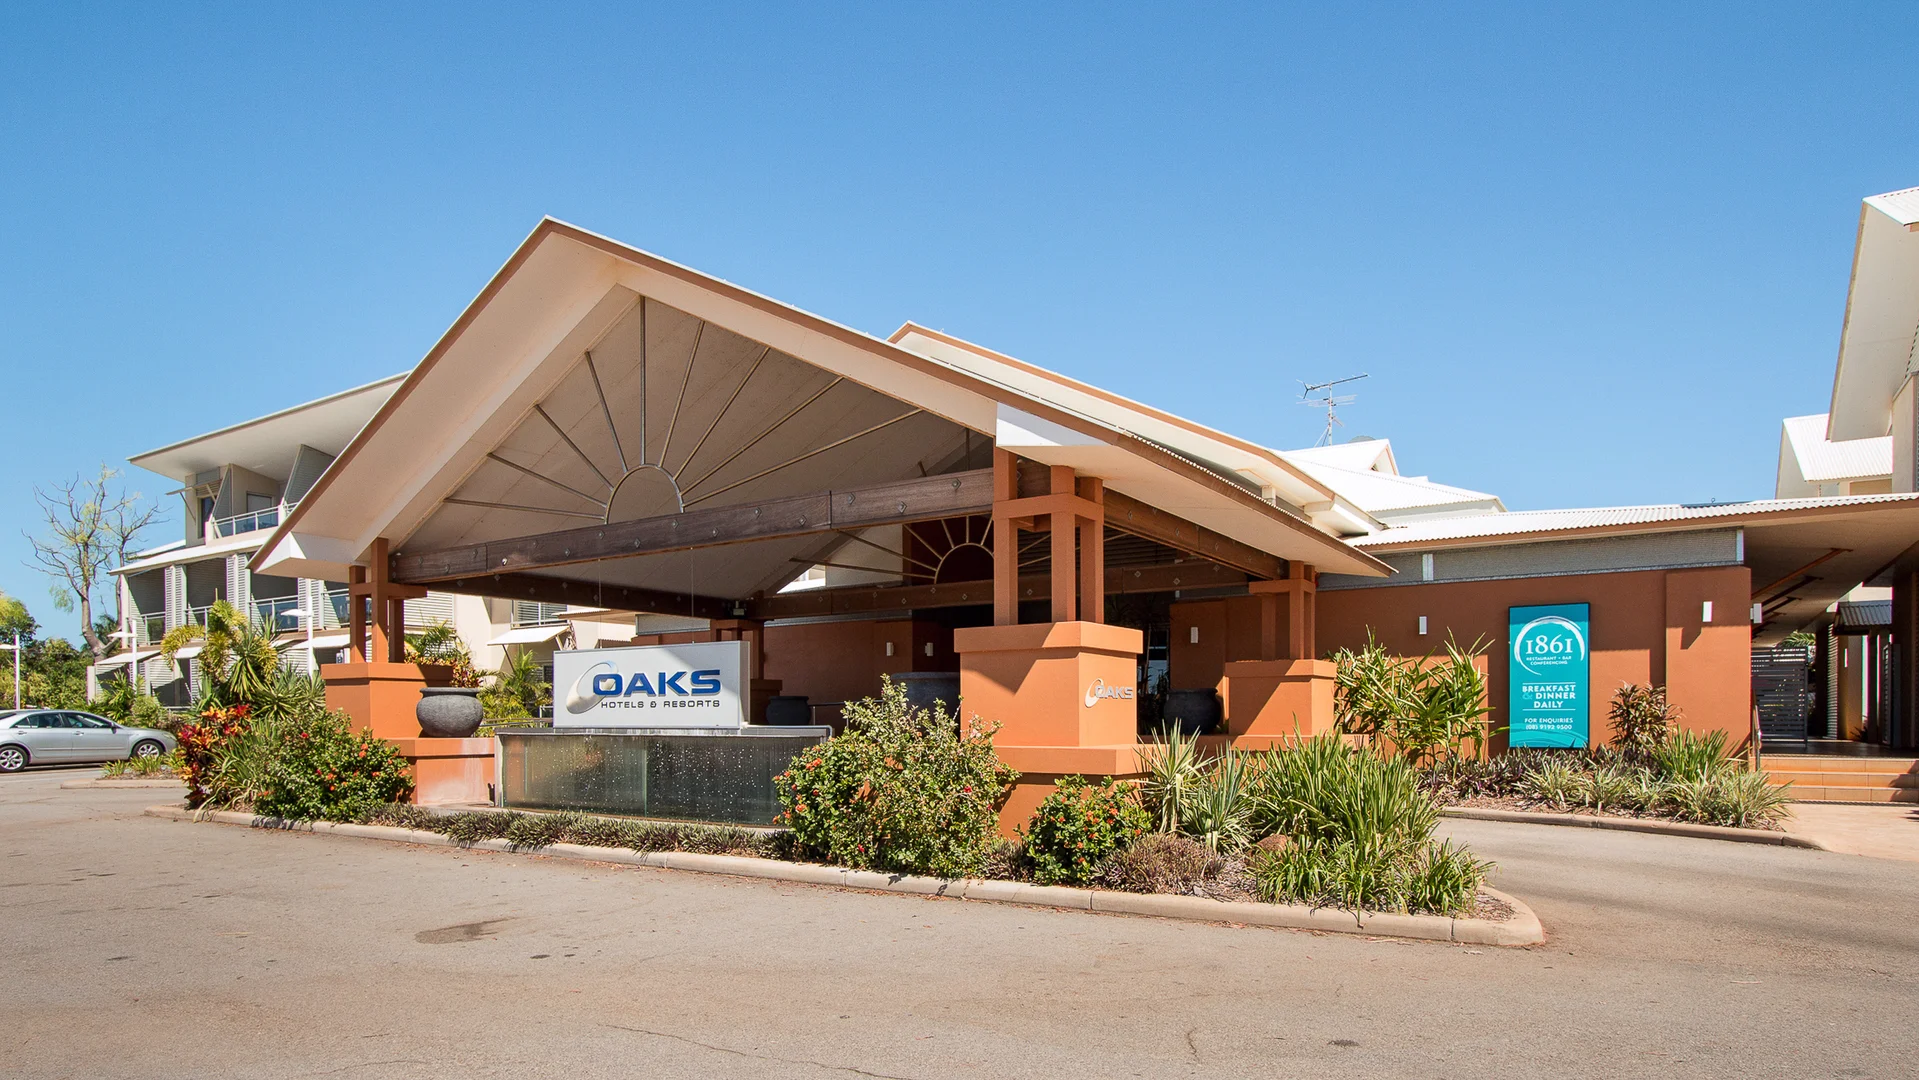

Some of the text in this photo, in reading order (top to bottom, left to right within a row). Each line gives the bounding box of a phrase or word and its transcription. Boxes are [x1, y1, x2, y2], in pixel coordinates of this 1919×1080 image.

[1526, 634, 1573, 654] 1861
[593, 669, 721, 697] OAKS
[1095, 685, 1133, 700] OAKS
[601, 700, 644, 708] HOTELS
[664, 700, 720, 708] RESORTS
